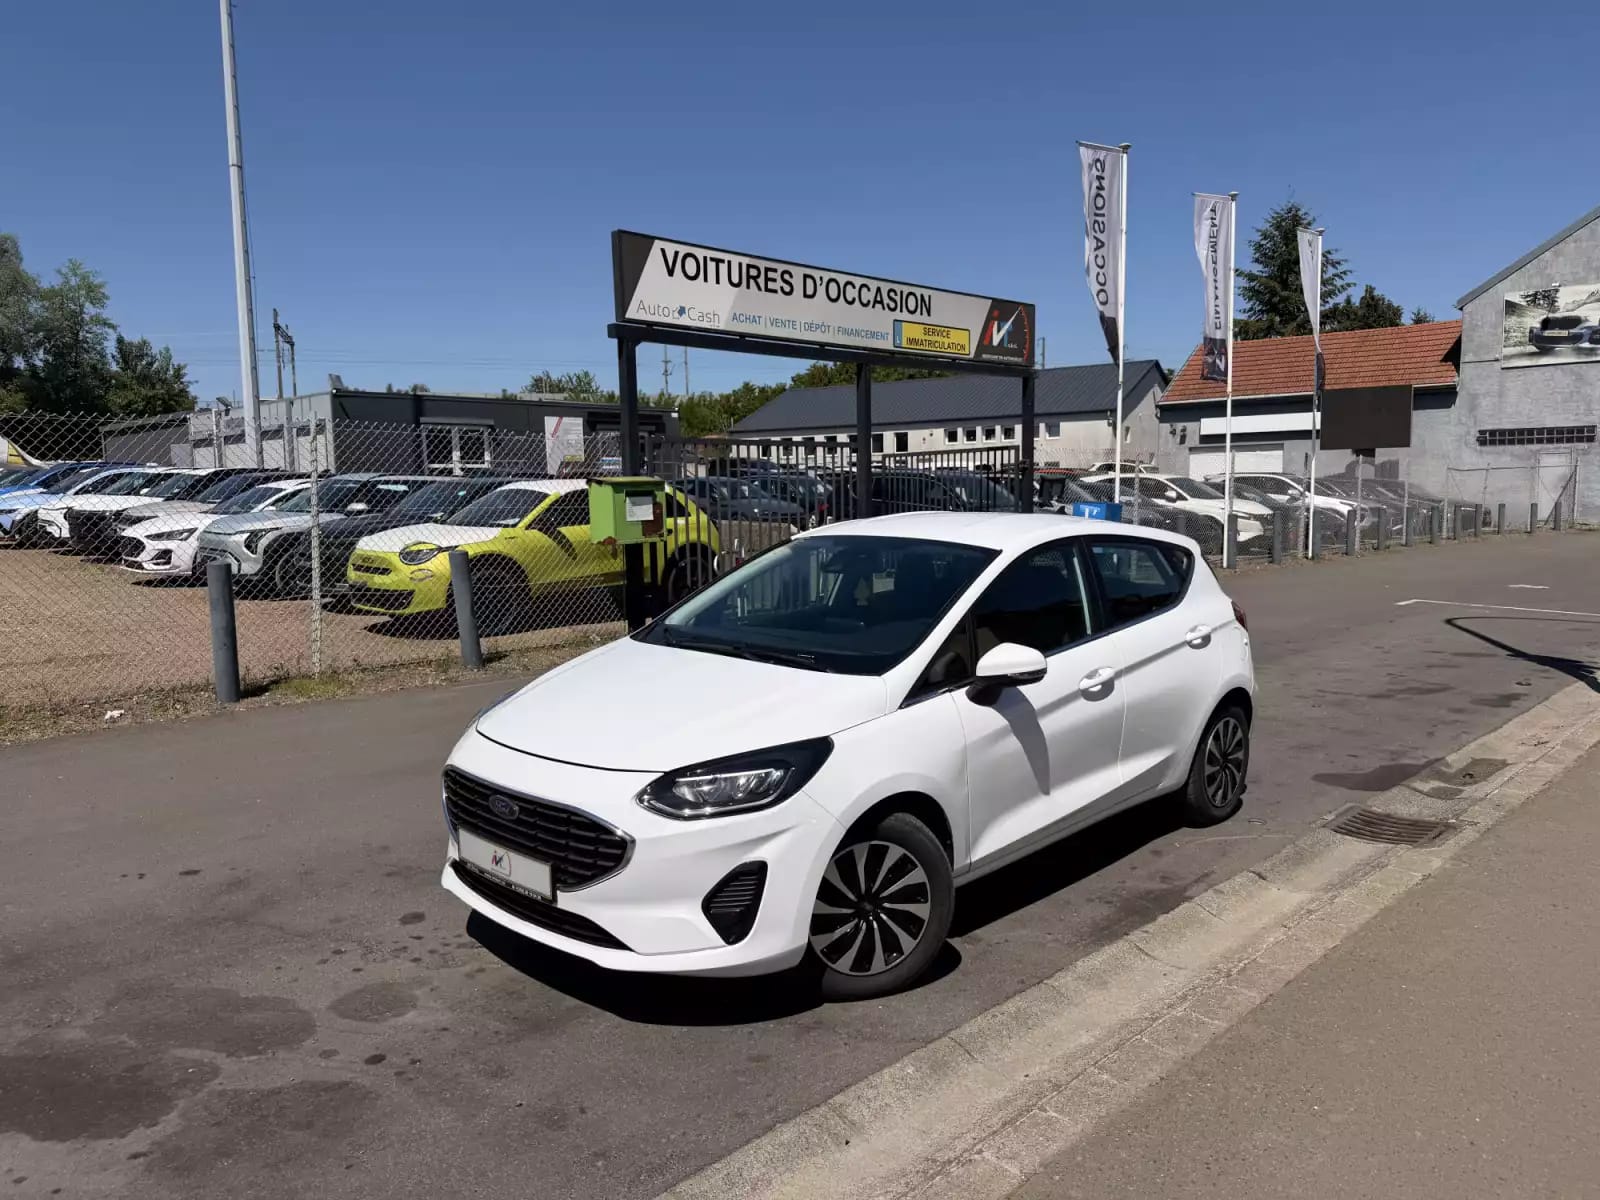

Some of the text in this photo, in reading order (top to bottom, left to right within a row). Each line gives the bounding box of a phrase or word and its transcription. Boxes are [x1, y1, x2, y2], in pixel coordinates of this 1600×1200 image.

[660, 248, 932, 317] VOITURES D'OCCASION
[636, 300, 720, 325] Auto Cash
[731, 312, 889, 342] ACHAT VENTE DÉPÔT FINANCEMENT
[922, 326, 951, 339] SERVICE
[906, 336, 966, 352] IMMATRICULATION
